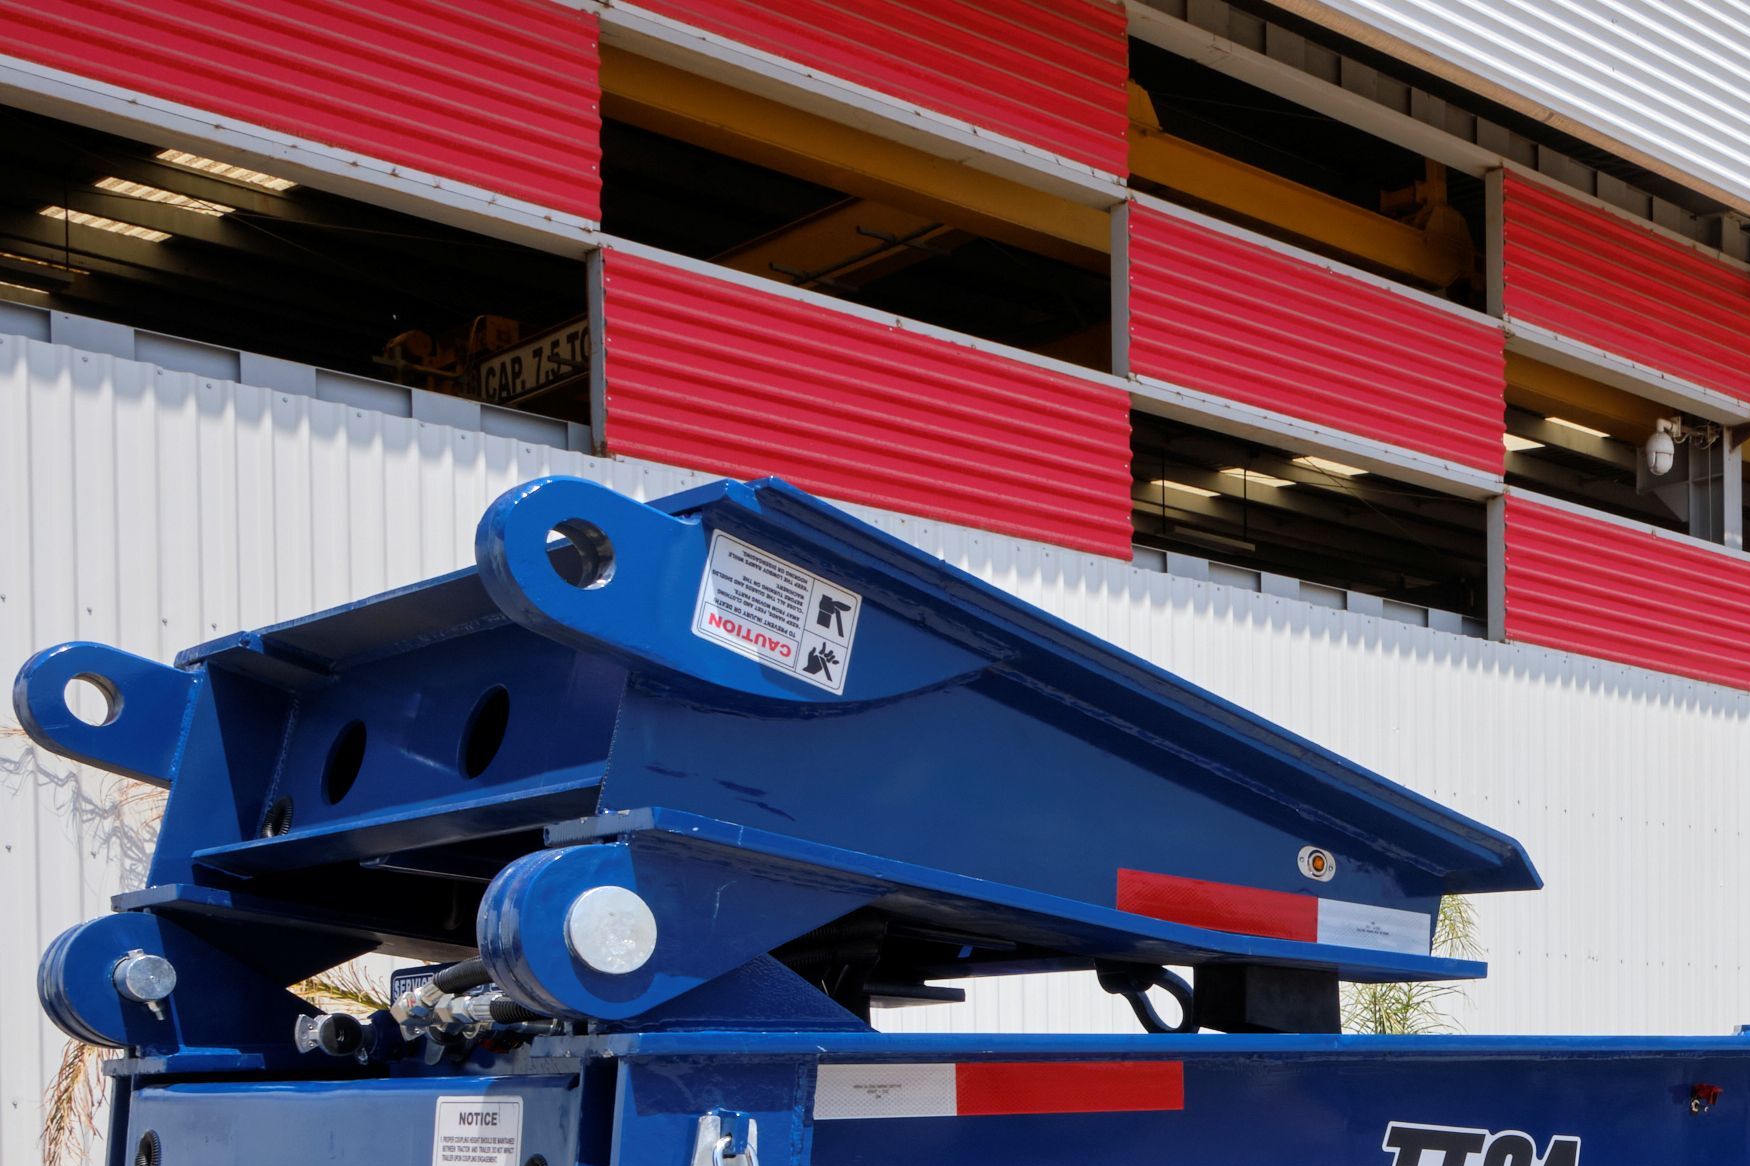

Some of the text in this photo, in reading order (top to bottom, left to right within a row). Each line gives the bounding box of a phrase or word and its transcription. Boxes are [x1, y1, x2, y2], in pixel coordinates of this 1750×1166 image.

[485, 355, 526, 401] CAP.
[708, 612, 791, 658] CAUTION
[458, 1112, 498, 1126] NOTICE
